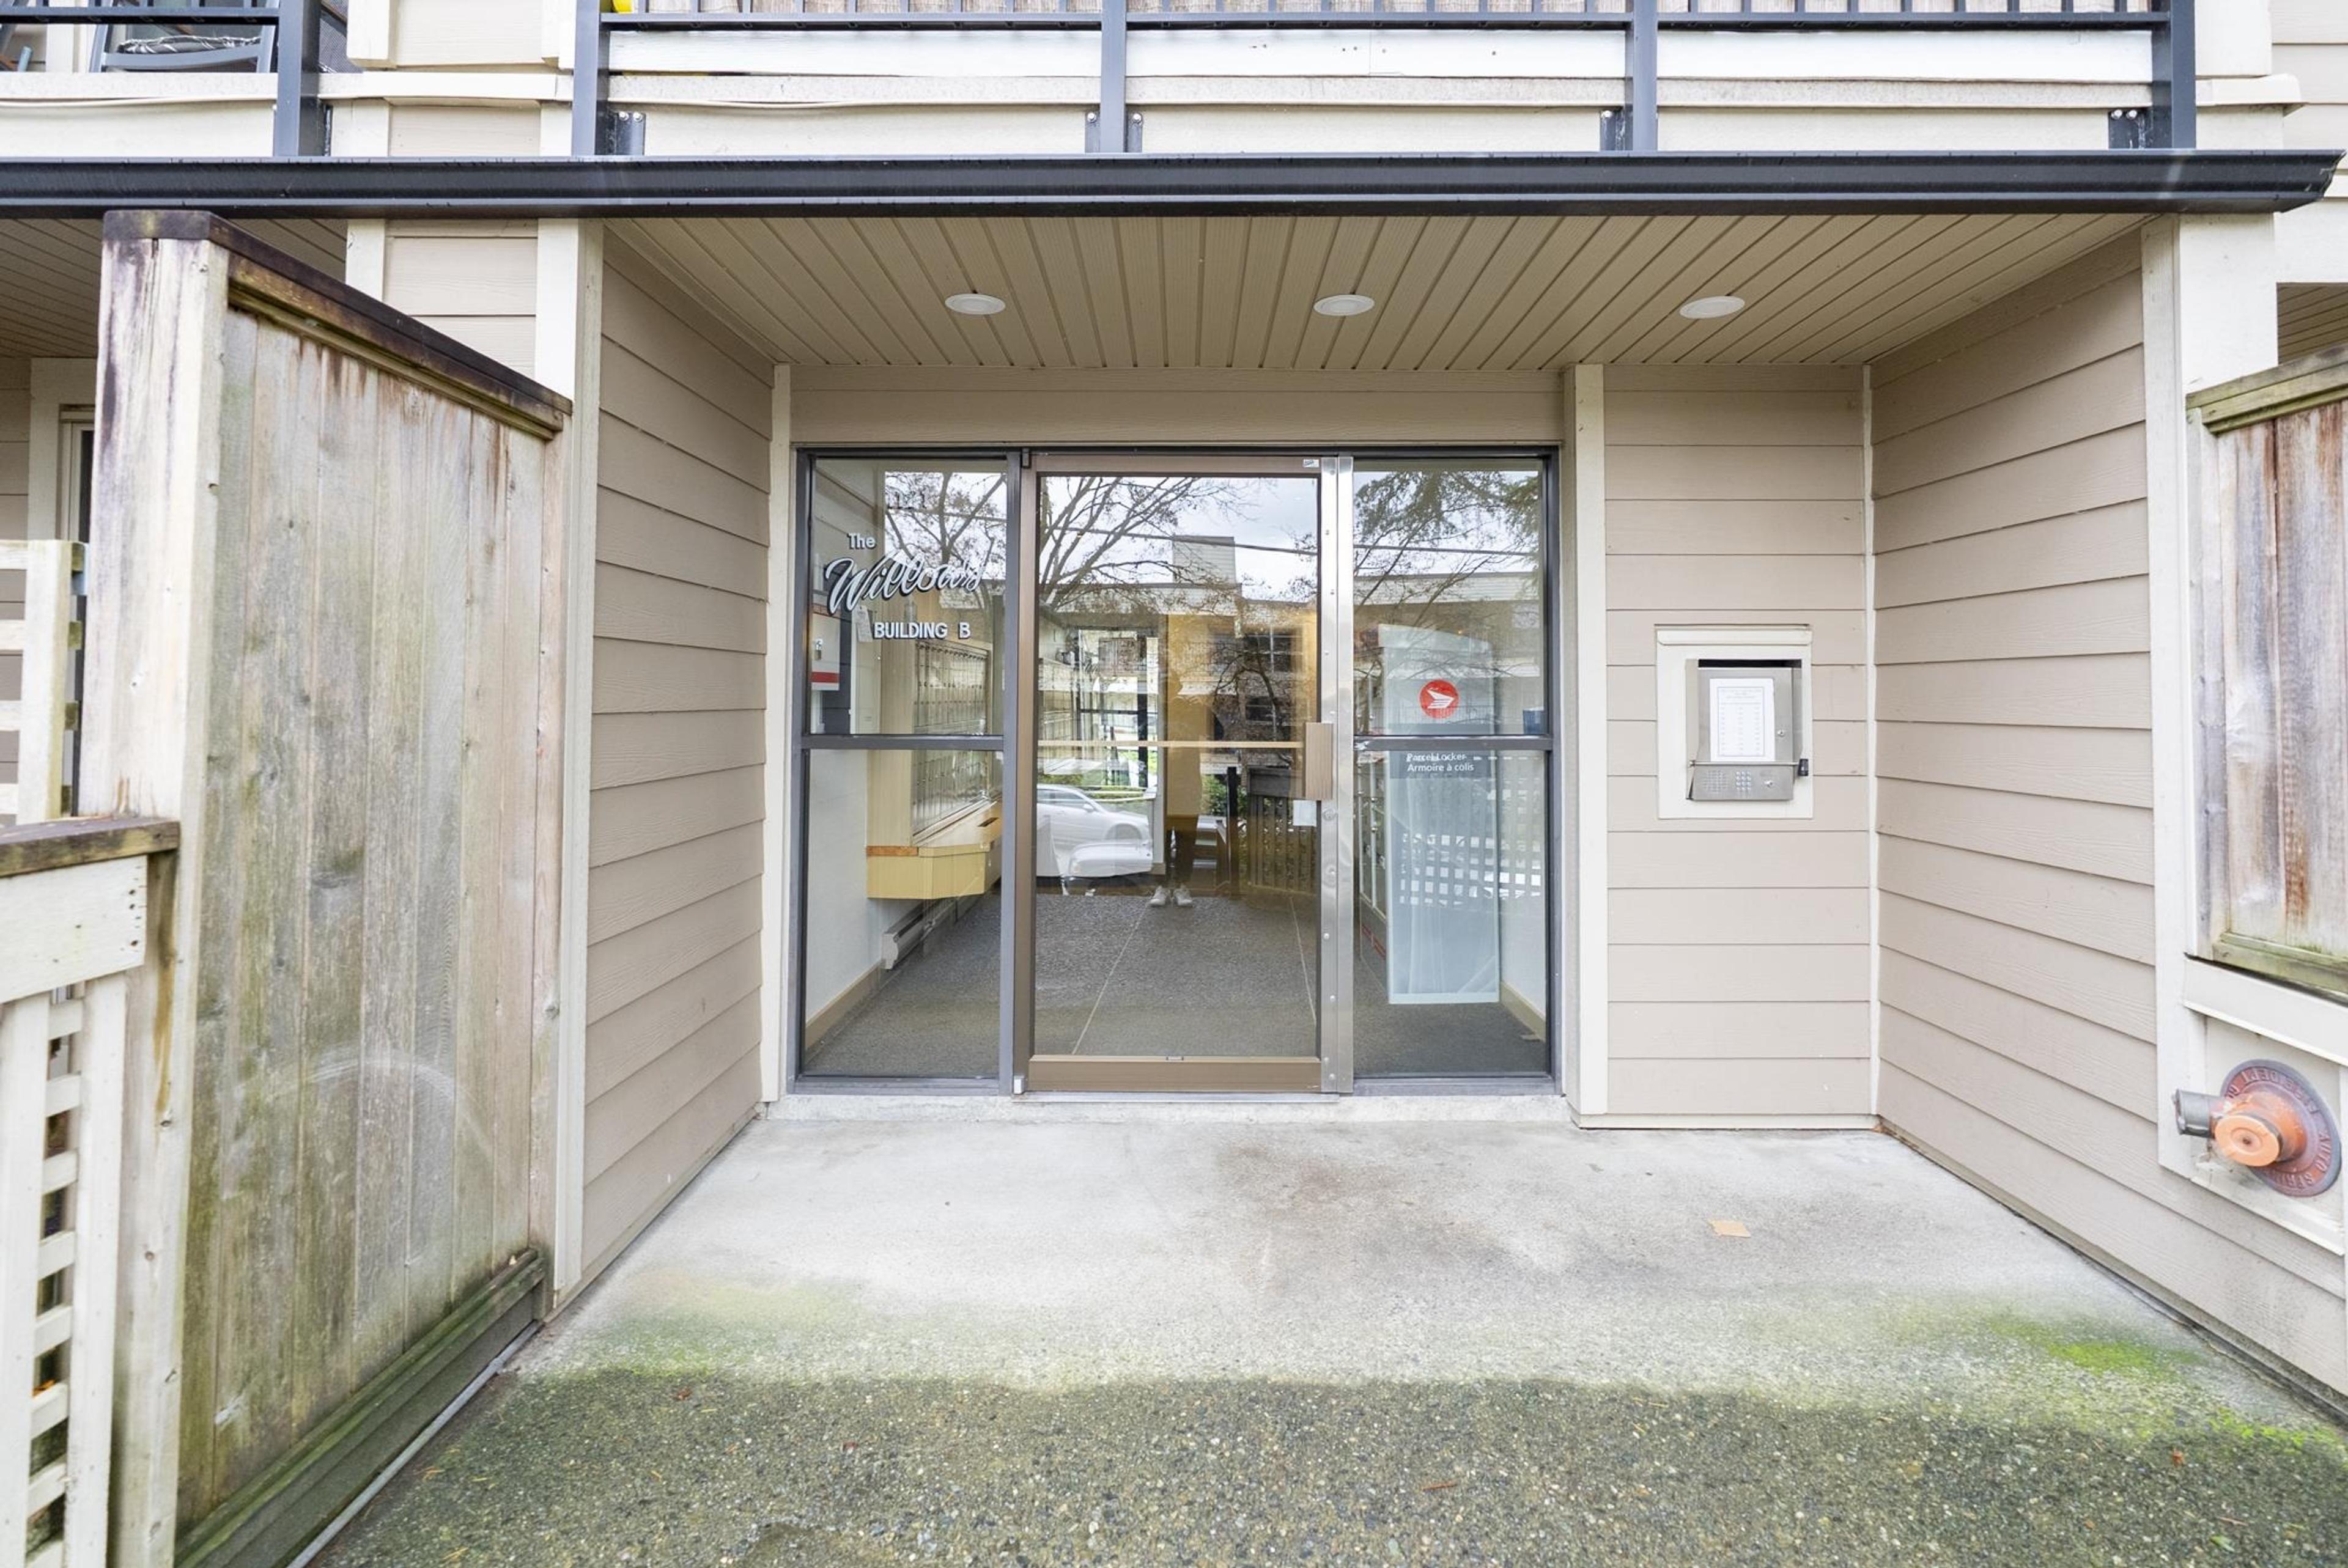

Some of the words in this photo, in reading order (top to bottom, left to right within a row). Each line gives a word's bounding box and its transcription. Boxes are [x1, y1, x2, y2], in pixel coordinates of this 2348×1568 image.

[847, 532, 876, 550] The
[824, 549, 985, 614] Willows
[873, 622, 948, 639] BUILDING
[958, 622, 972, 639] B
[1407, 763, 1444, 771] Armoire
[1454, 762, 1474, 771] colis
